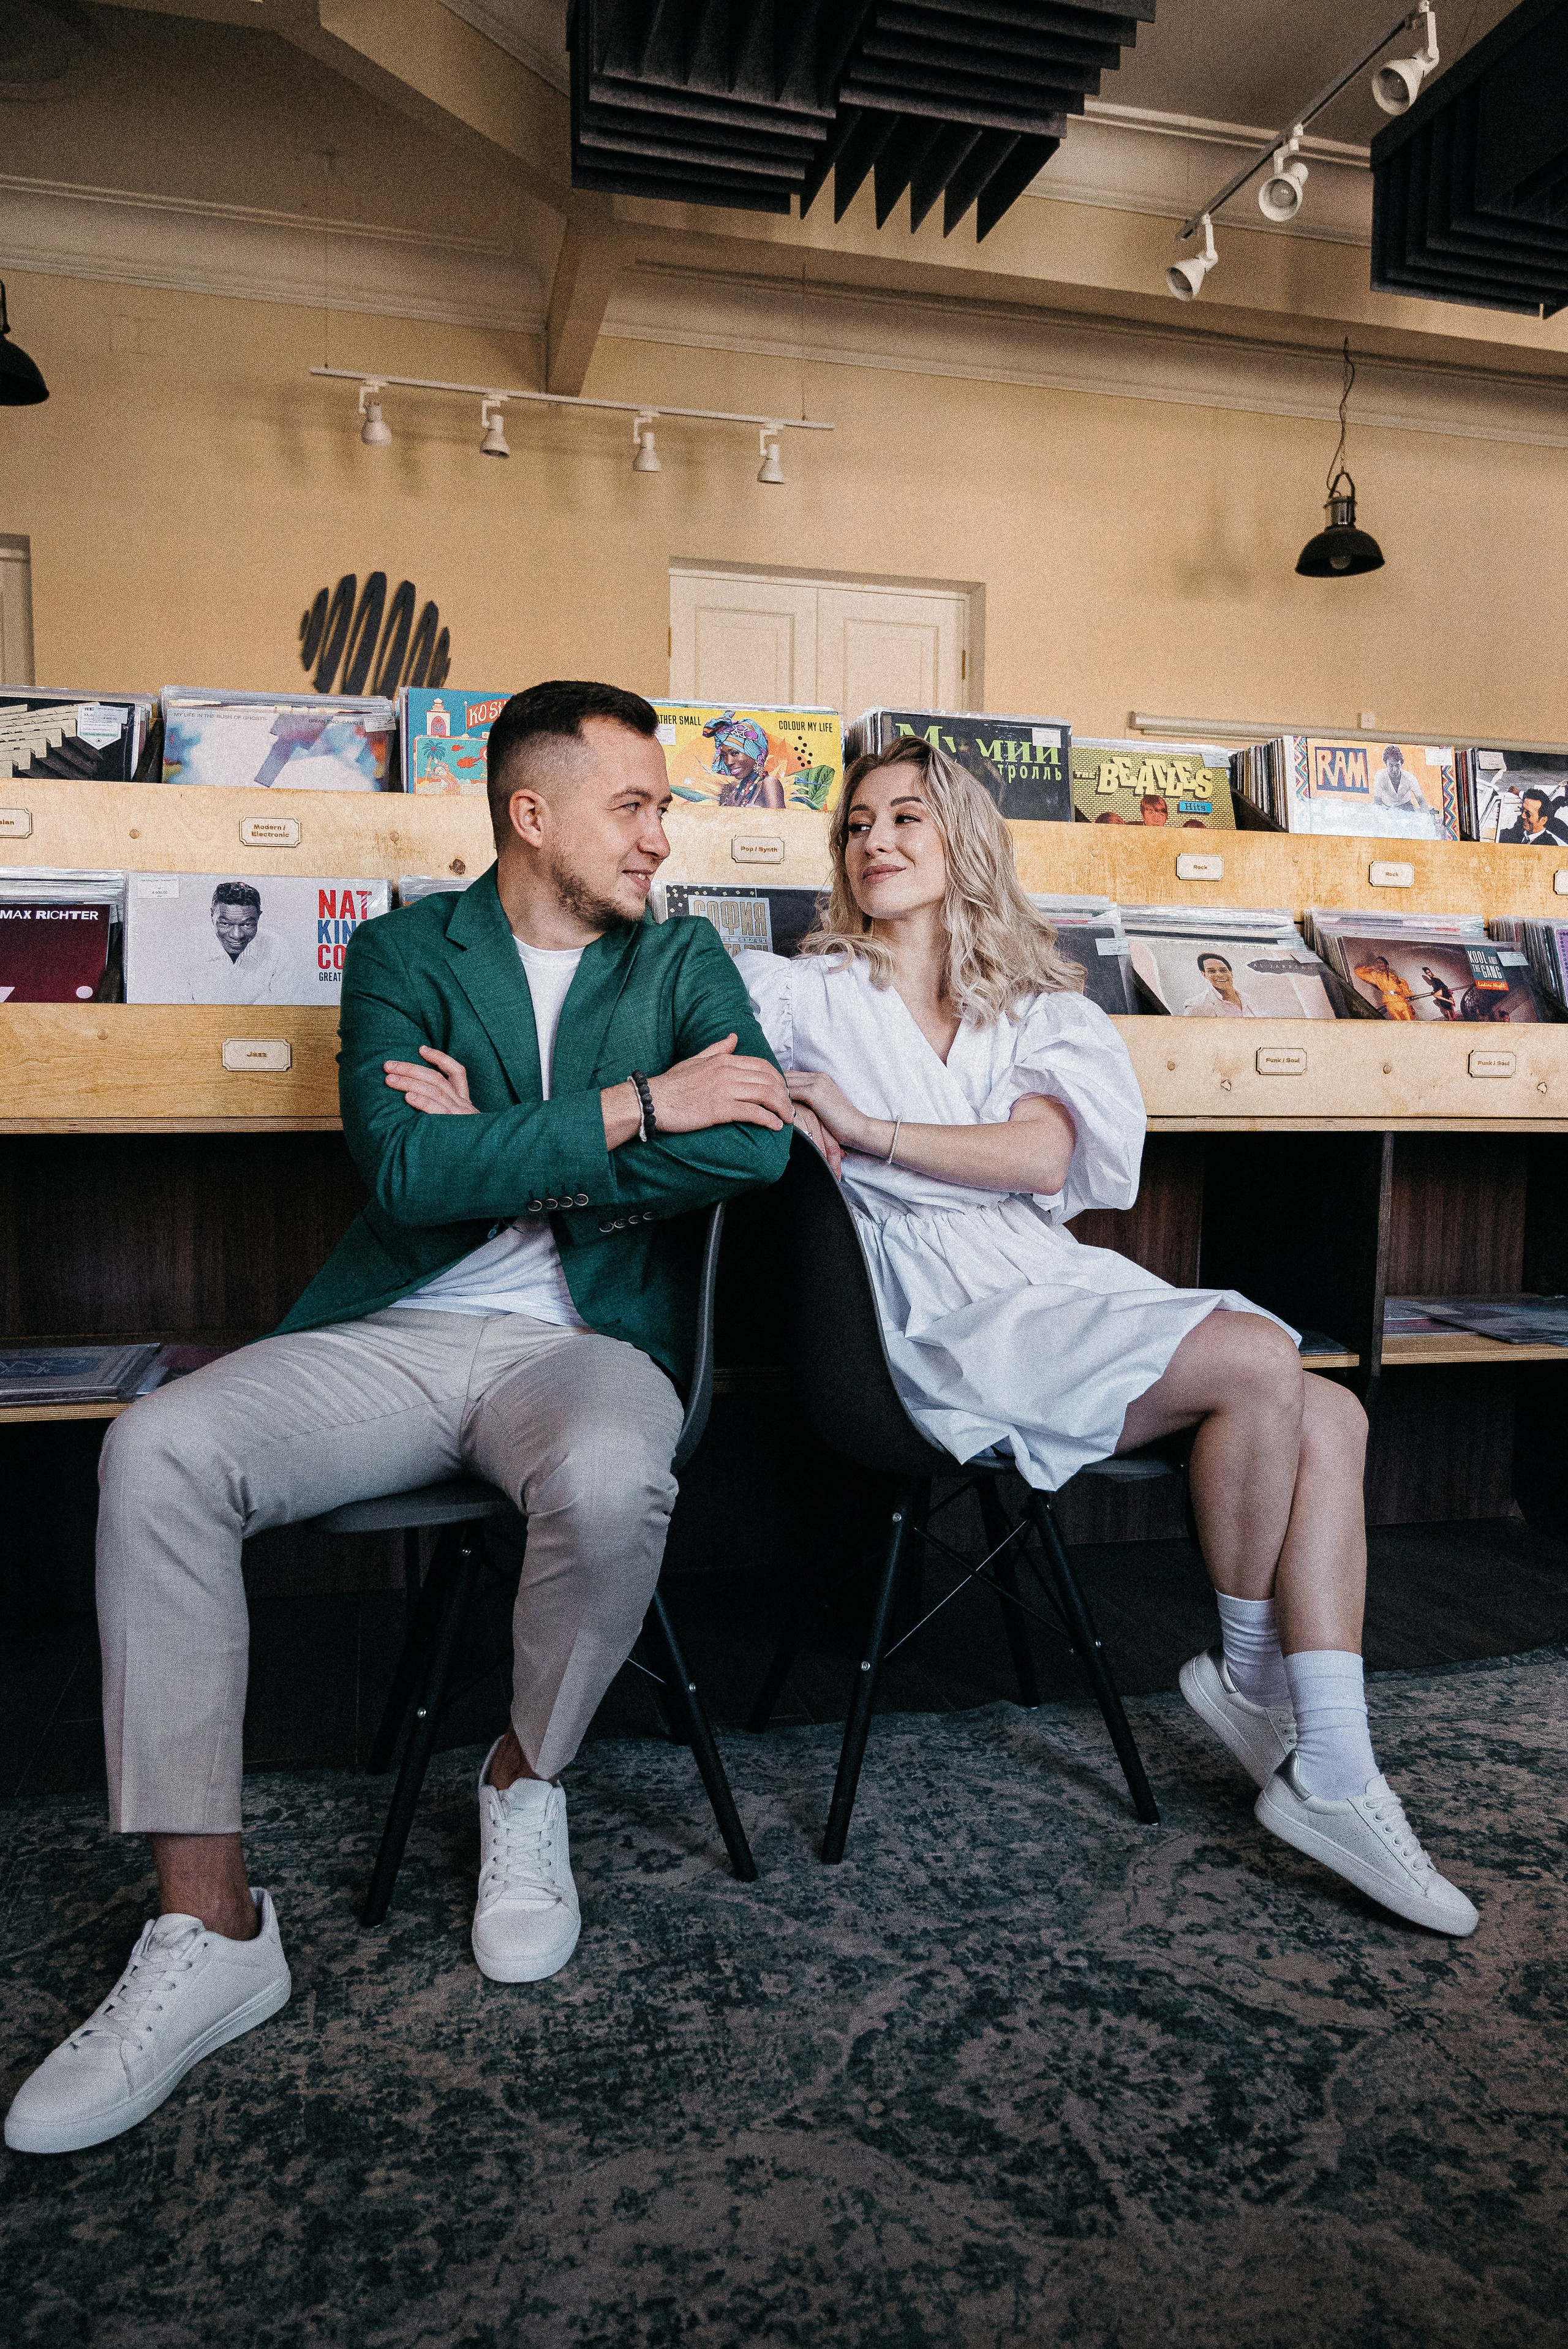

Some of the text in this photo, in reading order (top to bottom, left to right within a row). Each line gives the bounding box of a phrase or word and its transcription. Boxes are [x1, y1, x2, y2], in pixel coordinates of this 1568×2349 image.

[679, 715, 701, 726] SMALL
[778, 720, 833, 733] COLOUR MY LIFE
[1316, 750, 1368, 788] RAM
[1097, 756, 1214, 799] BEATLES
[1185, 802, 1206, 812] Hits
[318, 889, 372, 919] NAT
[0, 910, 99, 920] MAX RICHTER
[317, 919, 356, 944] KIN
[317, 945, 346, 969] CO
[1468, 951, 1498, 965] KOOL AND
[318, 972, 342, 981] GREAT
[1472, 964, 1503, 979] THE GANG
